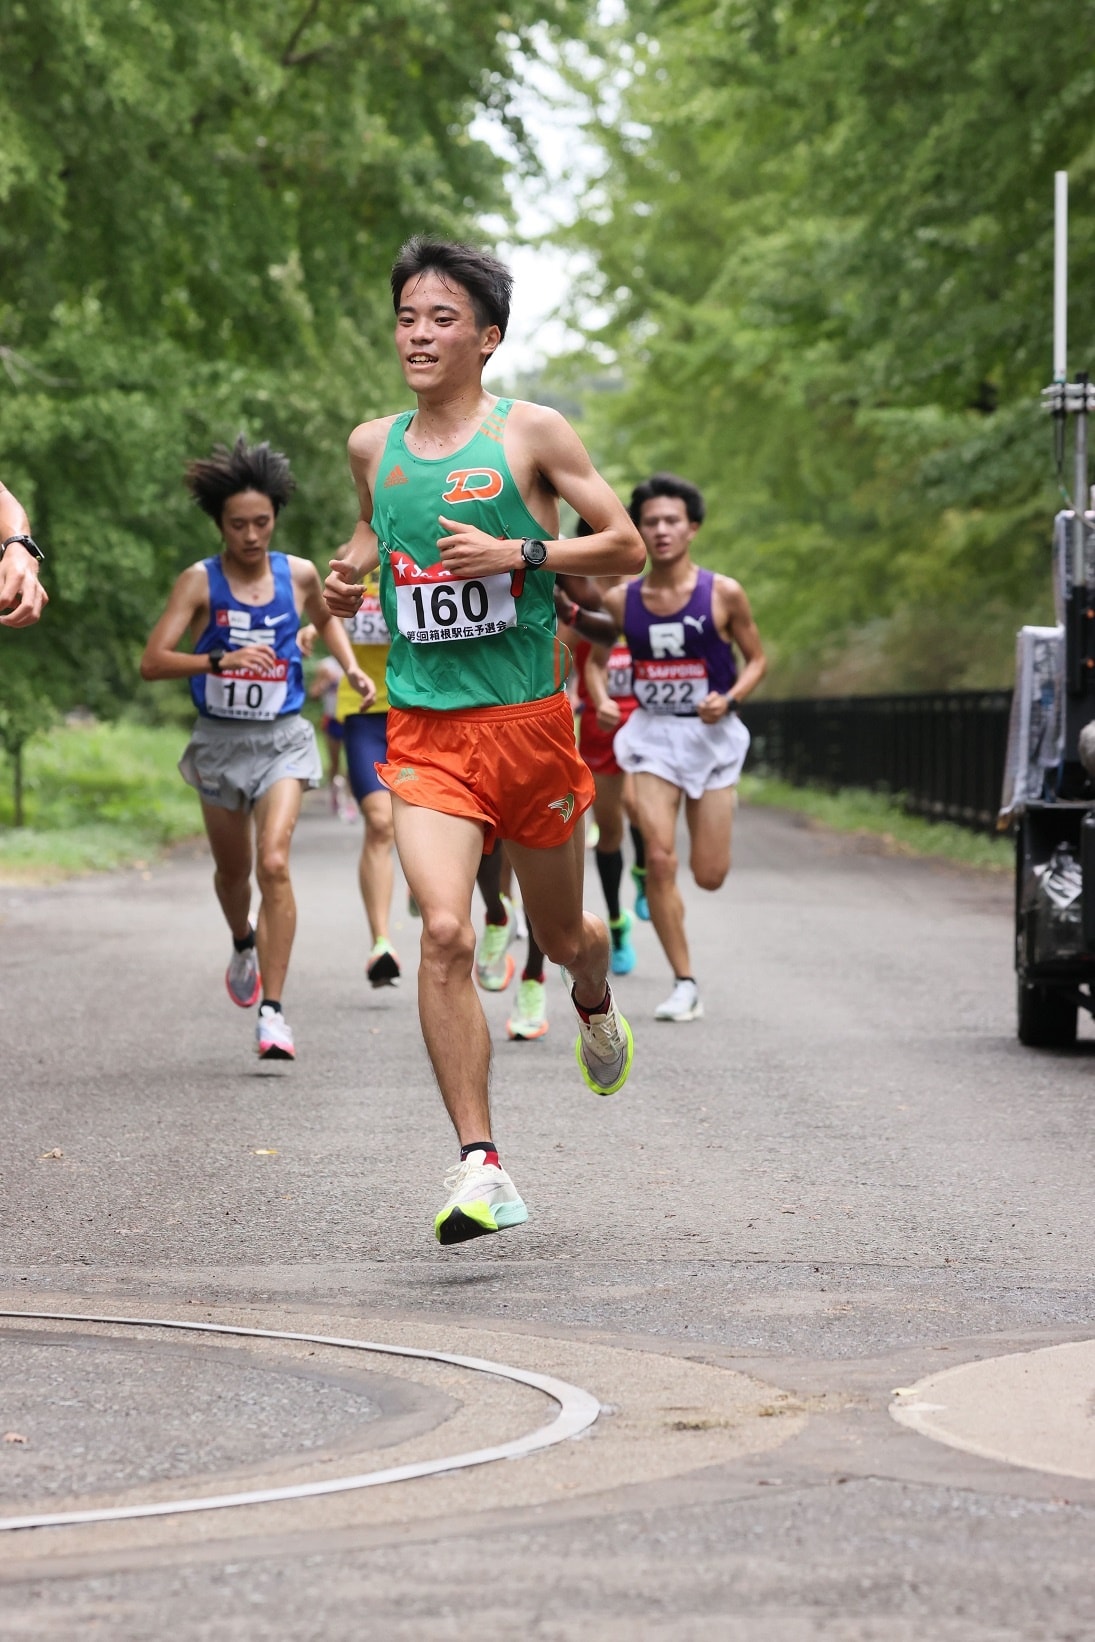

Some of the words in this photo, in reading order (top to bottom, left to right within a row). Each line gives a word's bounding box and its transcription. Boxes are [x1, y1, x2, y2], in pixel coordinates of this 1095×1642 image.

[442, 467, 504, 505] D
[412, 580, 488, 630] 160
[648, 621, 686, 659] R
[223, 681, 263, 709] 10
[645, 682, 693, 704] 222
